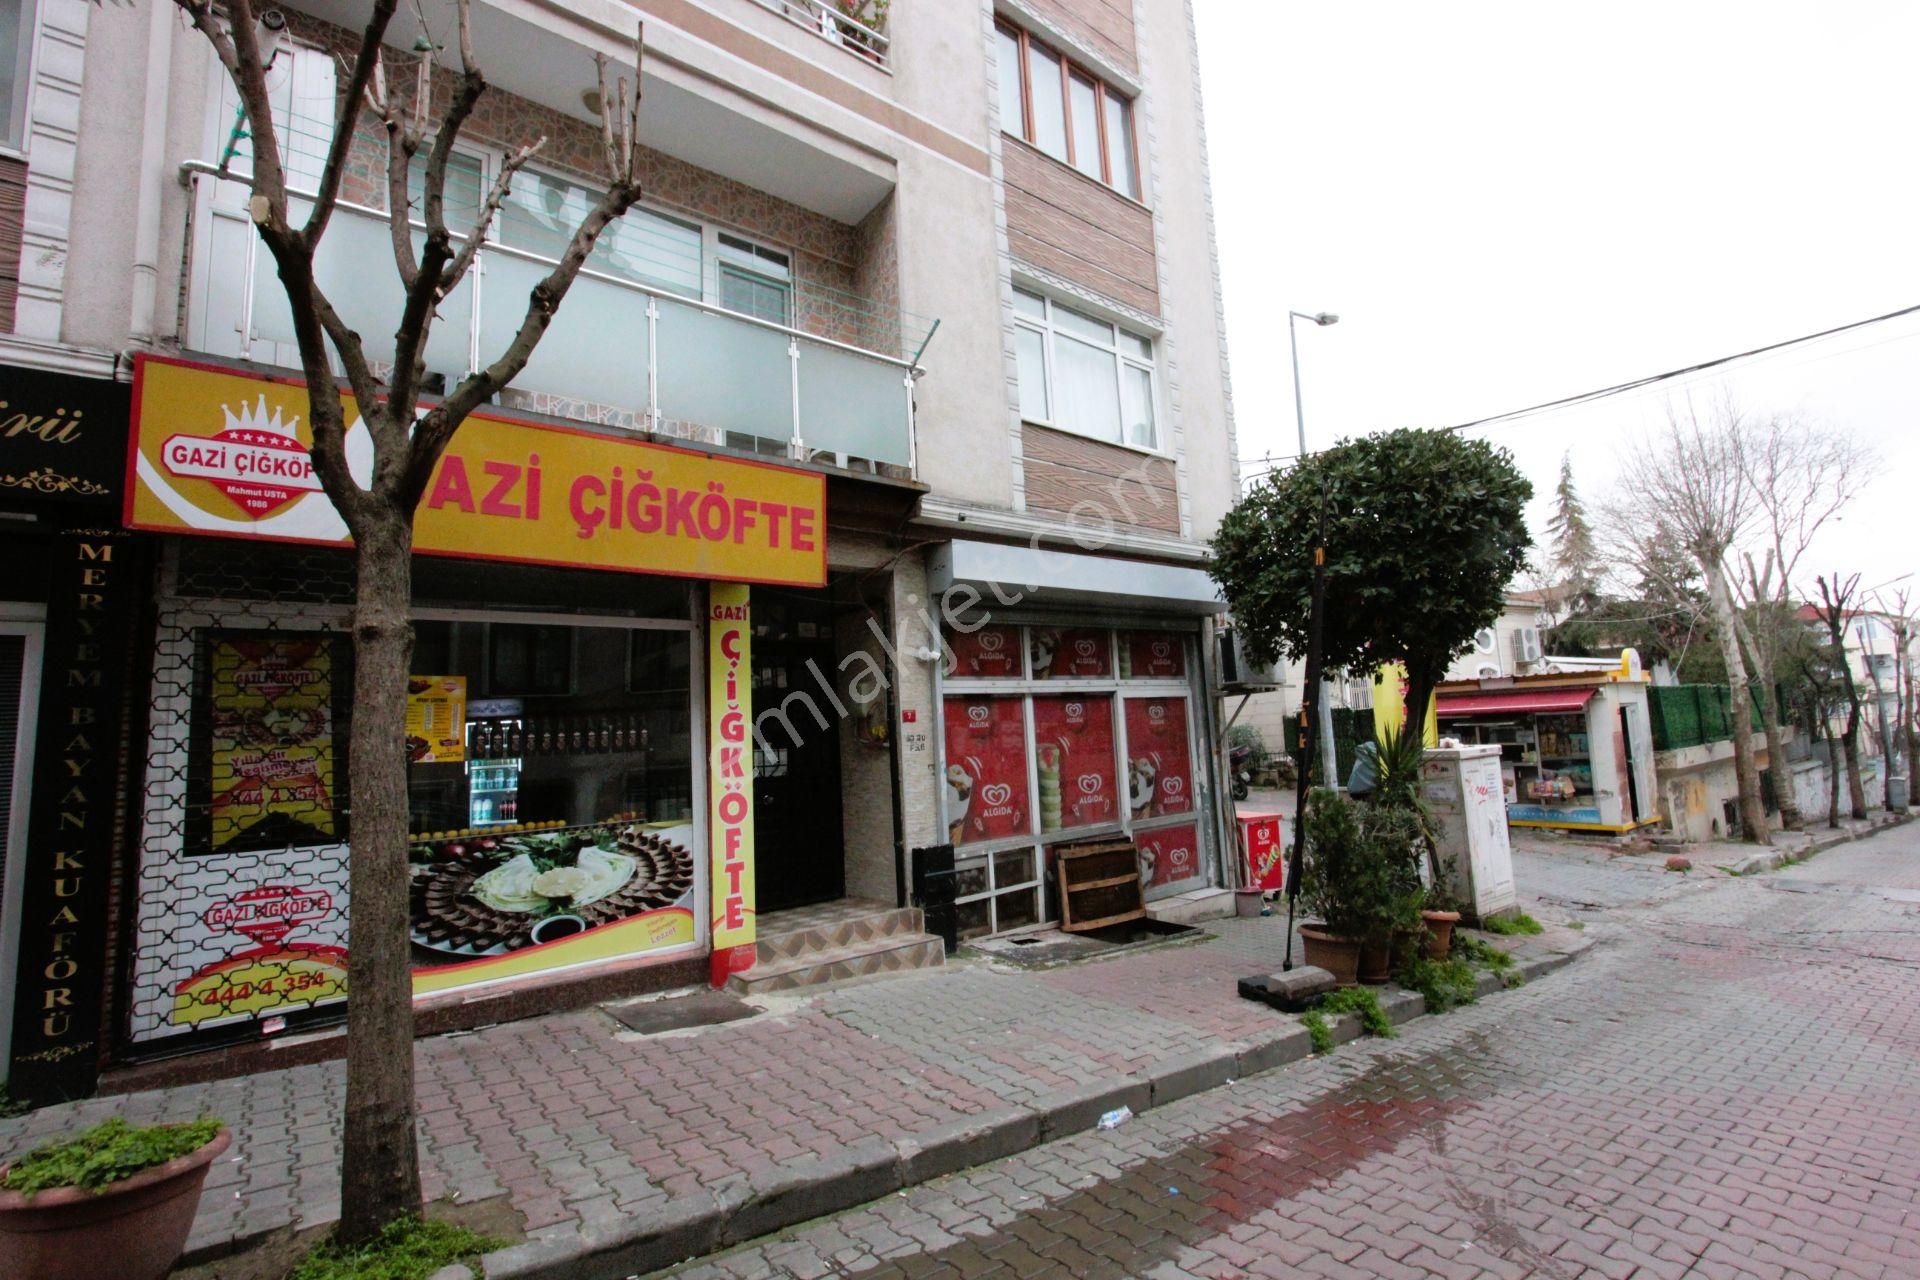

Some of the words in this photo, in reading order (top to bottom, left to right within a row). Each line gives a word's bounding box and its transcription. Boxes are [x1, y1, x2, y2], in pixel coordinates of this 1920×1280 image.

[0, 401, 83, 444] rü
[172, 445, 226, 469] GAZİ
[234, 450, 315, 479] ÇİĞKÖF
[227, 486, 262, 497] Mahmut
[264, 489, 287, 499] USTA
[427, 453, 542, 520] AZİ
[569, 465, 816, 552] ÇİĞKÖFTE
[67, 542, 113, 688] MERYEM
[713, 603, 748, 621] GAZİ
[59, 707, 96, 831] BAYAN
[718, 630, 748, 930] ÇİĞKÖFTE
[43, 849, 86, 1037] KUAFÖRÜ
